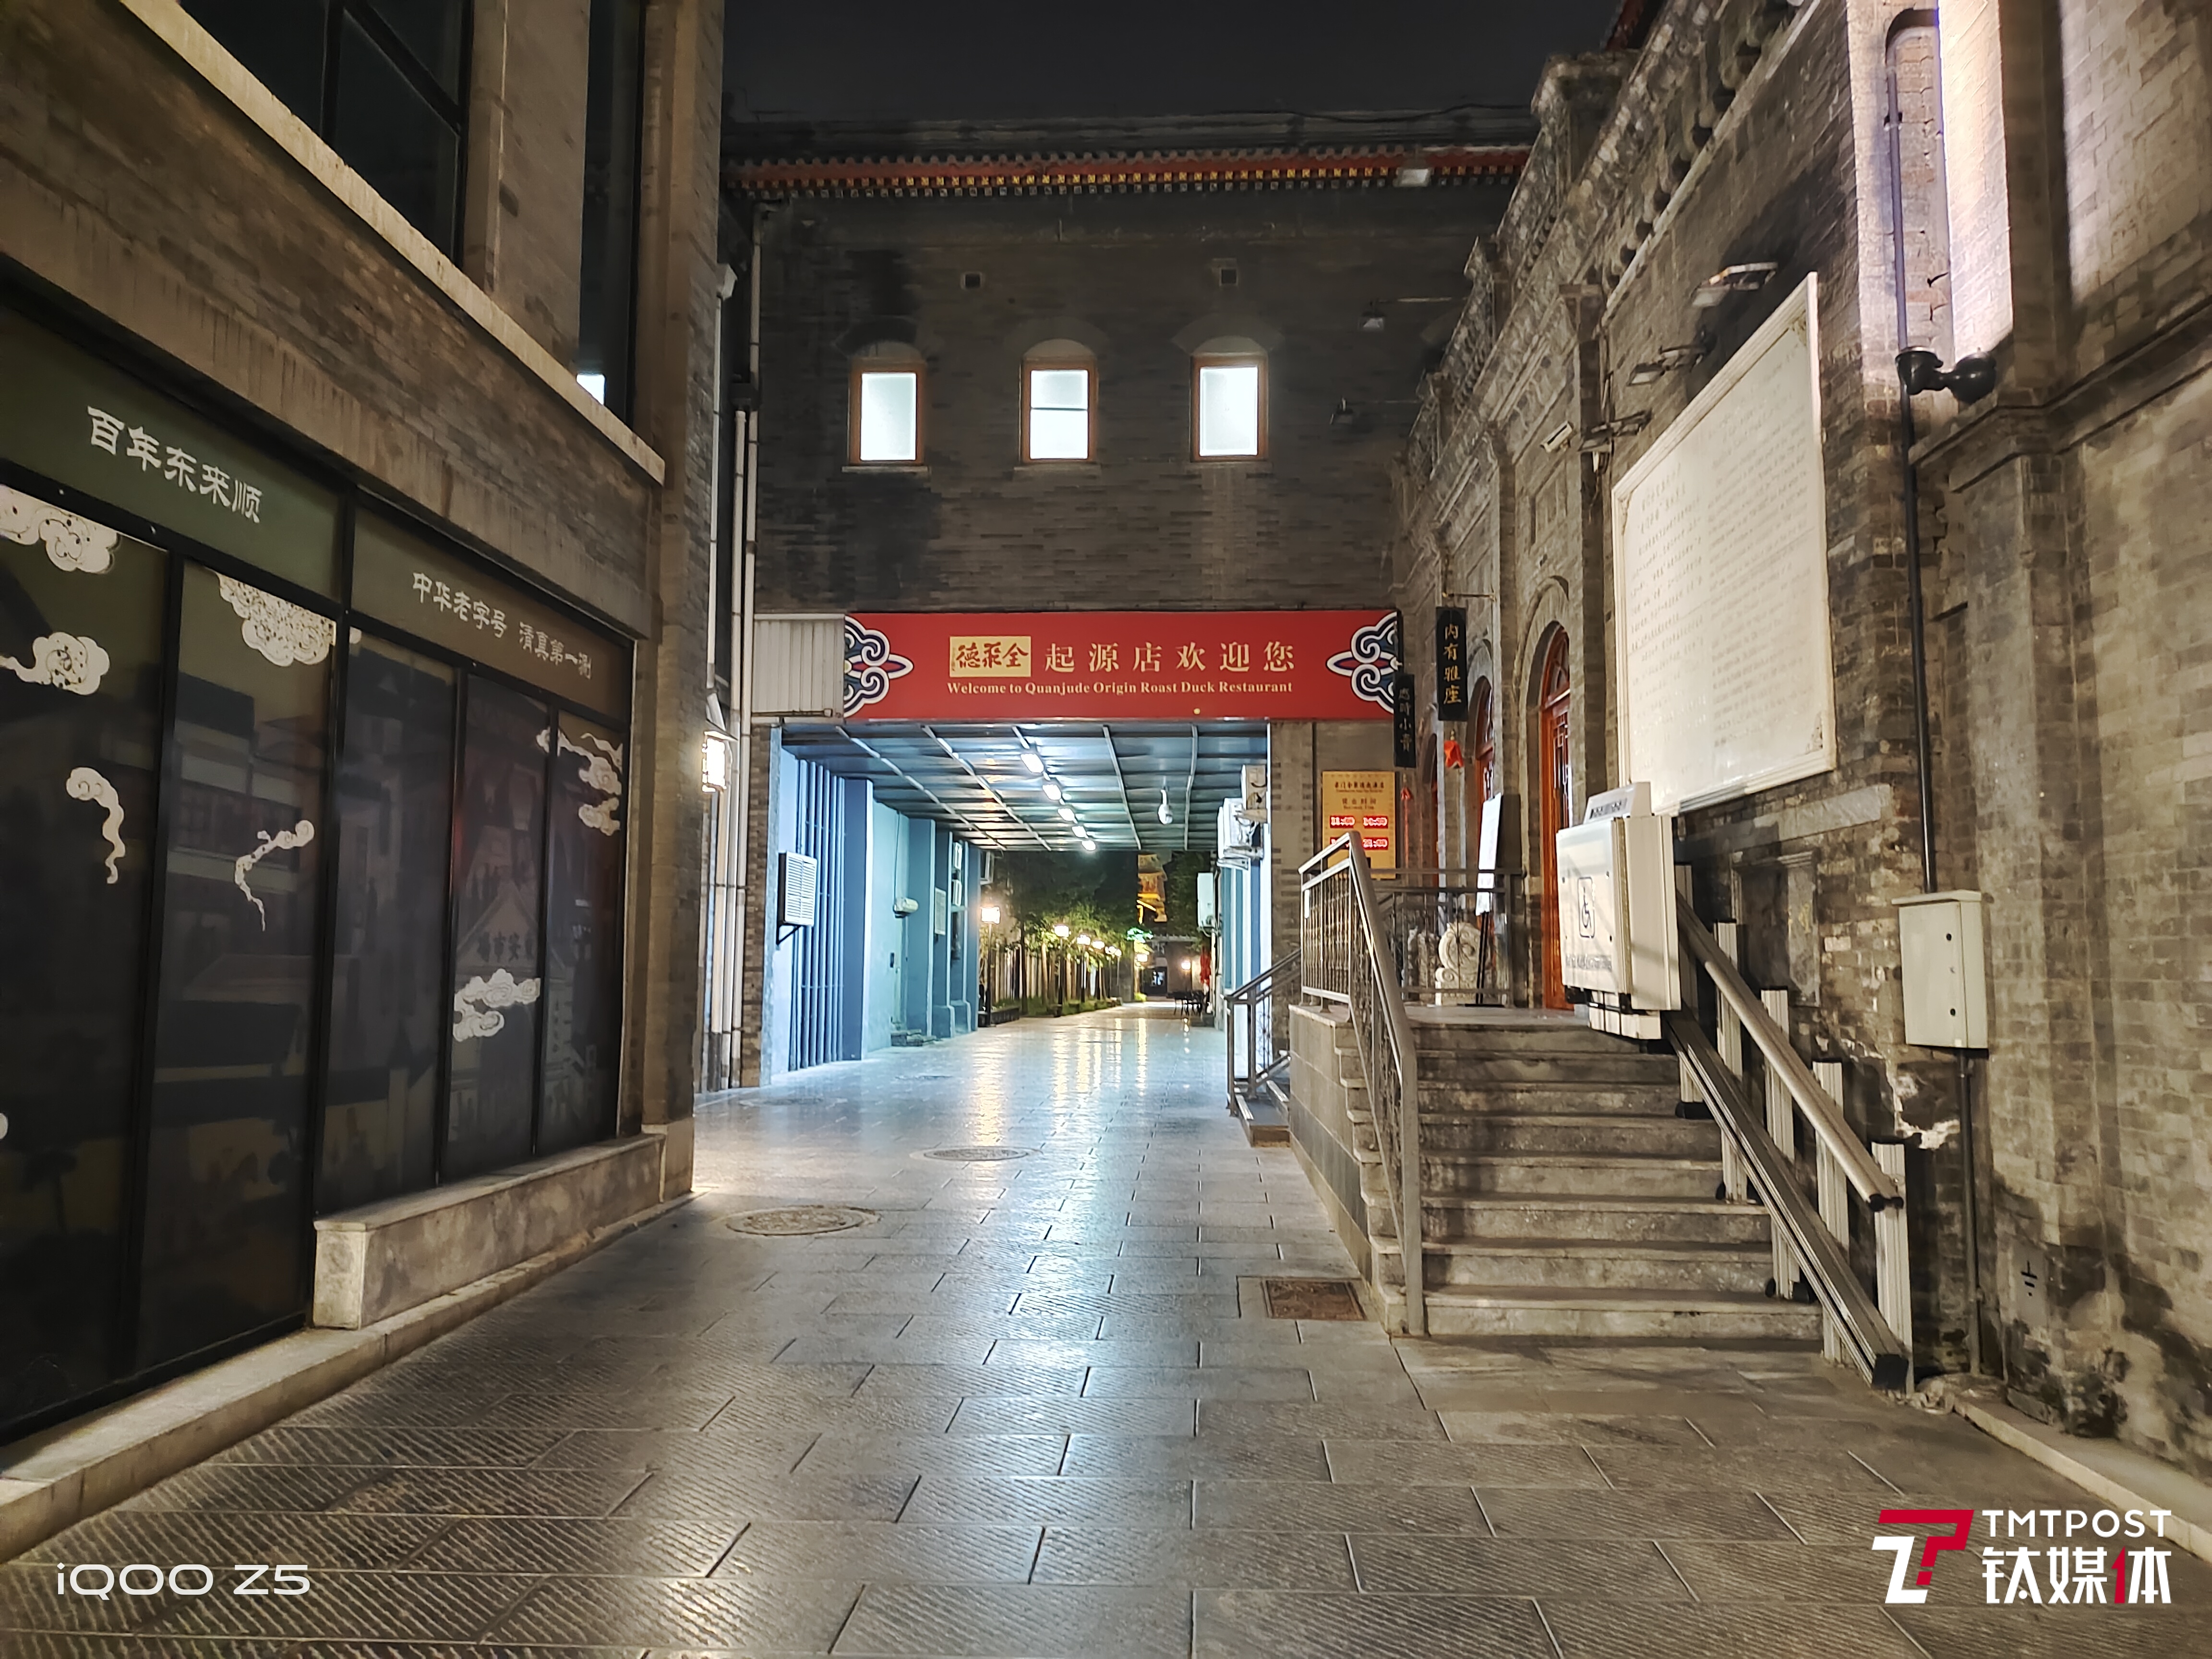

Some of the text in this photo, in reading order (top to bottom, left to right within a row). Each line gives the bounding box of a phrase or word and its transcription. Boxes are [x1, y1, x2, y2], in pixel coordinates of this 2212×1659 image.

[87, 405, 264, 523] 百年东来顺
[412, 572, 507, 638] 中华老字号
[1045, 641, 1295, 673] 起源店欢迎您
[947, 681, 1293, 696] Welcome to Quanjude Origin Roast Duck Restaurant
